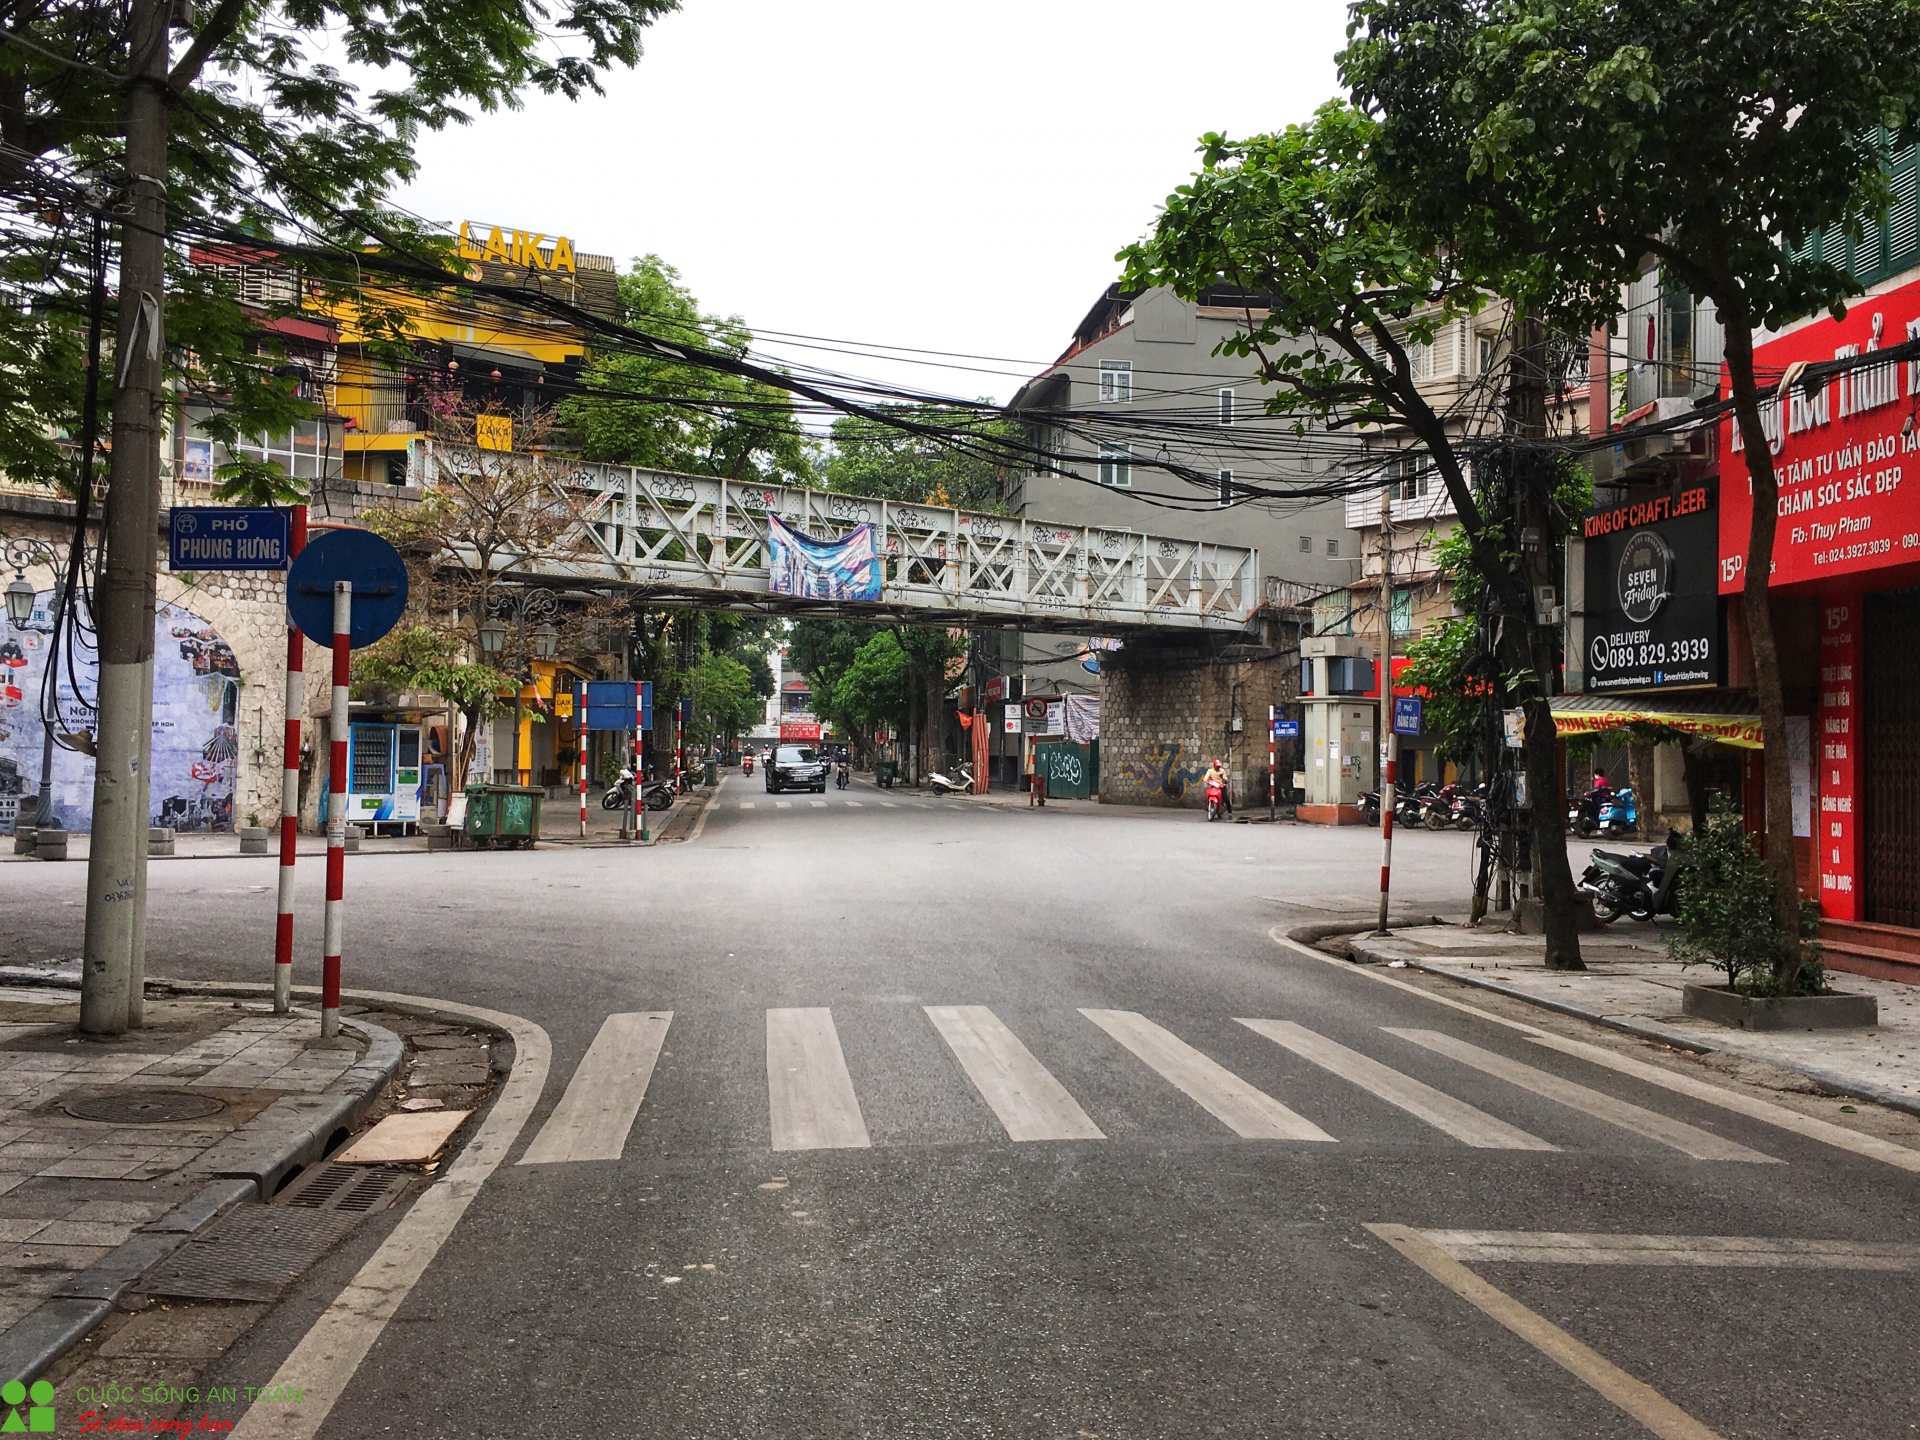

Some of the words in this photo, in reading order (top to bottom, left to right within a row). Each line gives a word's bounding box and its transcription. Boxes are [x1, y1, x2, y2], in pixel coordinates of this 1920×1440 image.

[460, 221, 576, 274] LAIKA
[480, 426, 508, 438] LAIKA
[1787, 457, 1814, 486] TÂM
[1816, 451, 1834, 477] TƯ
[1836, 437, 1862, 471] VẤN
[1866, 432, 1896, 464] ĐÀO
[1777, 487, 1814, 517] CHĂM
[1818, 478, 1842, 507] SÓC
[1846, 467, 1872, 501] SẮC
[1875, 466, 1902, 497] ĐẸP
[211, 514, 249, 531] PHỐ
[1585, 512, 1611, 538] KING
[1612, 507, 1628, 531] OF
[1629, 496, 1671, 527] CRAFT
[1791, 527, 1808, 545] Fb:
[1810, 522, 1837, 542] Thuy
[1838, 515, 1871, 535] Pham
[180, 533, 232, 559] PHÙNG
[236, 536, 280, 559] HƯNG
[1628, 568, 1657, 587] SEVEN
[1721, 554, 1743, 582] 15D
[1624, 583, 1665, 611] Friday
[1825, 606, 1849, 630] 15D
[1610, 628, 1651, 647] DELIVERY
[1609, 637, 1709, 668] 089.829.3939
[1403, 702, 1412, 712] PHỐ
[1555, 714, 1587, 732] BÚN
